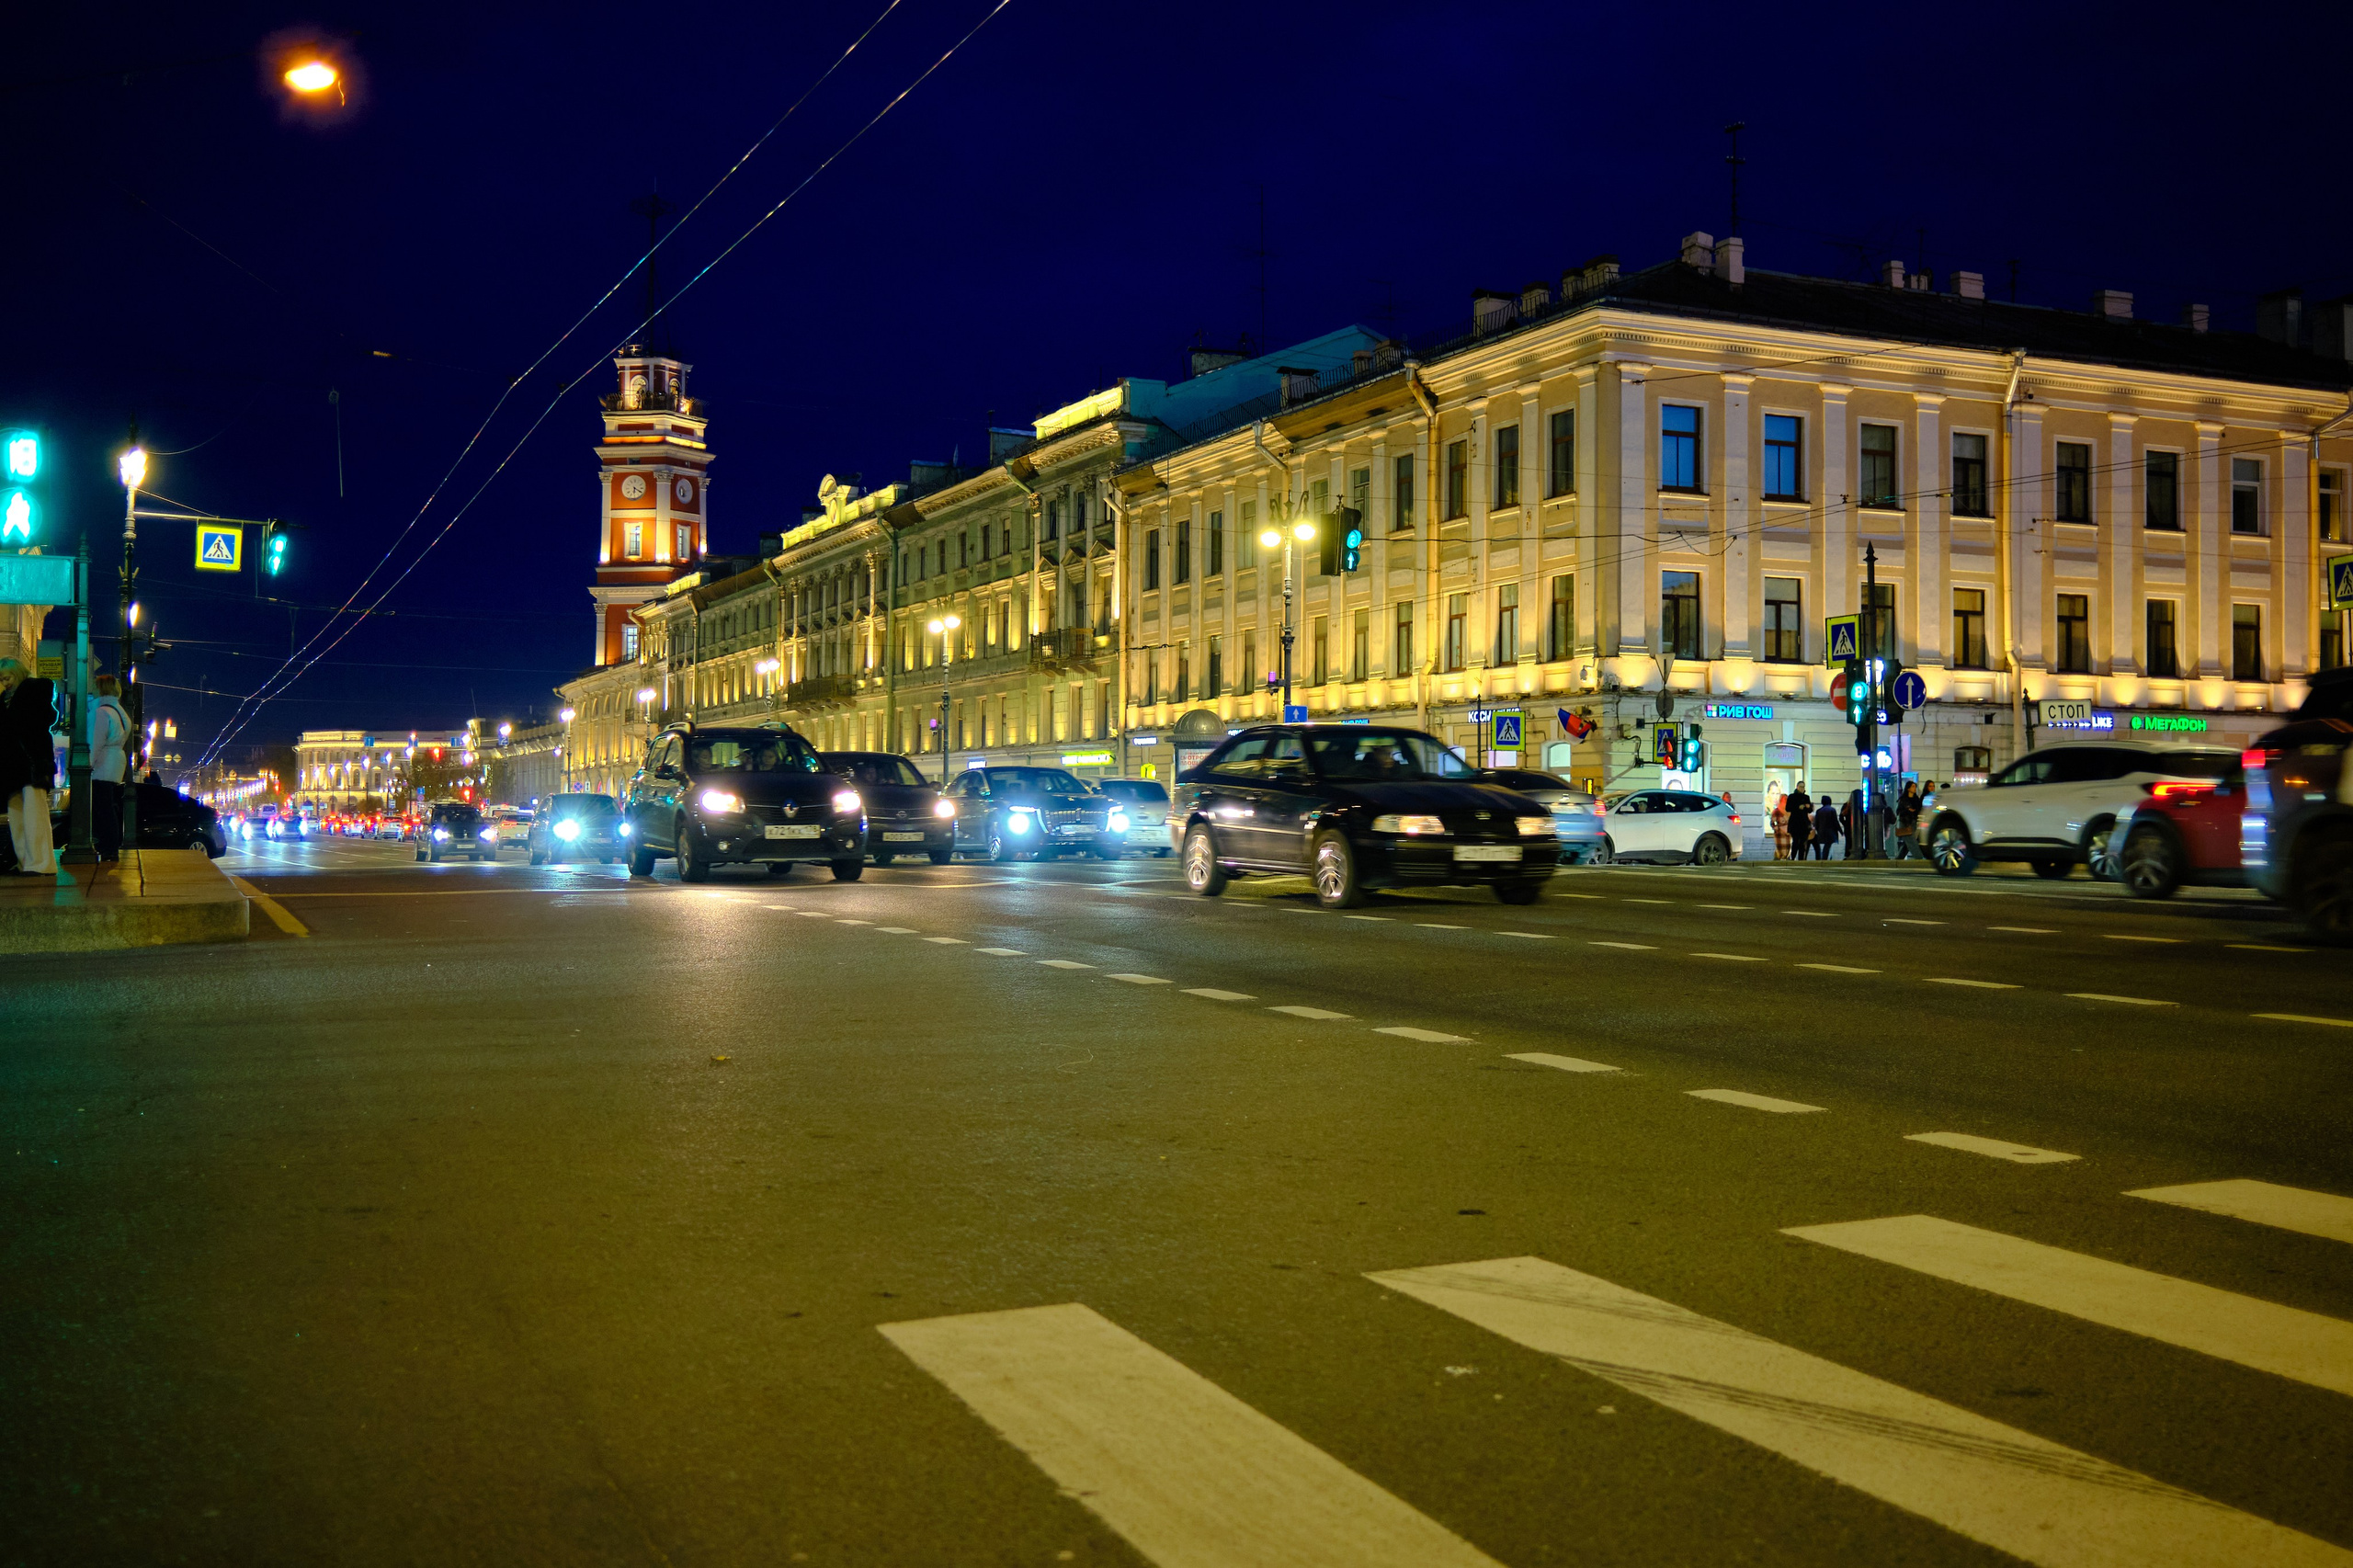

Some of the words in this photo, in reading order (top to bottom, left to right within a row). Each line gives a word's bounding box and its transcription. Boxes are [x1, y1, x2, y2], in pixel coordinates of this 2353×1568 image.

[1718, 705, 1745, 718] РИВ
[1746, 706, 1772, 719] ГОШ
[2048, 704, 2085, 720] СТОП
[2092, 716, 2113, 728] LIKE
